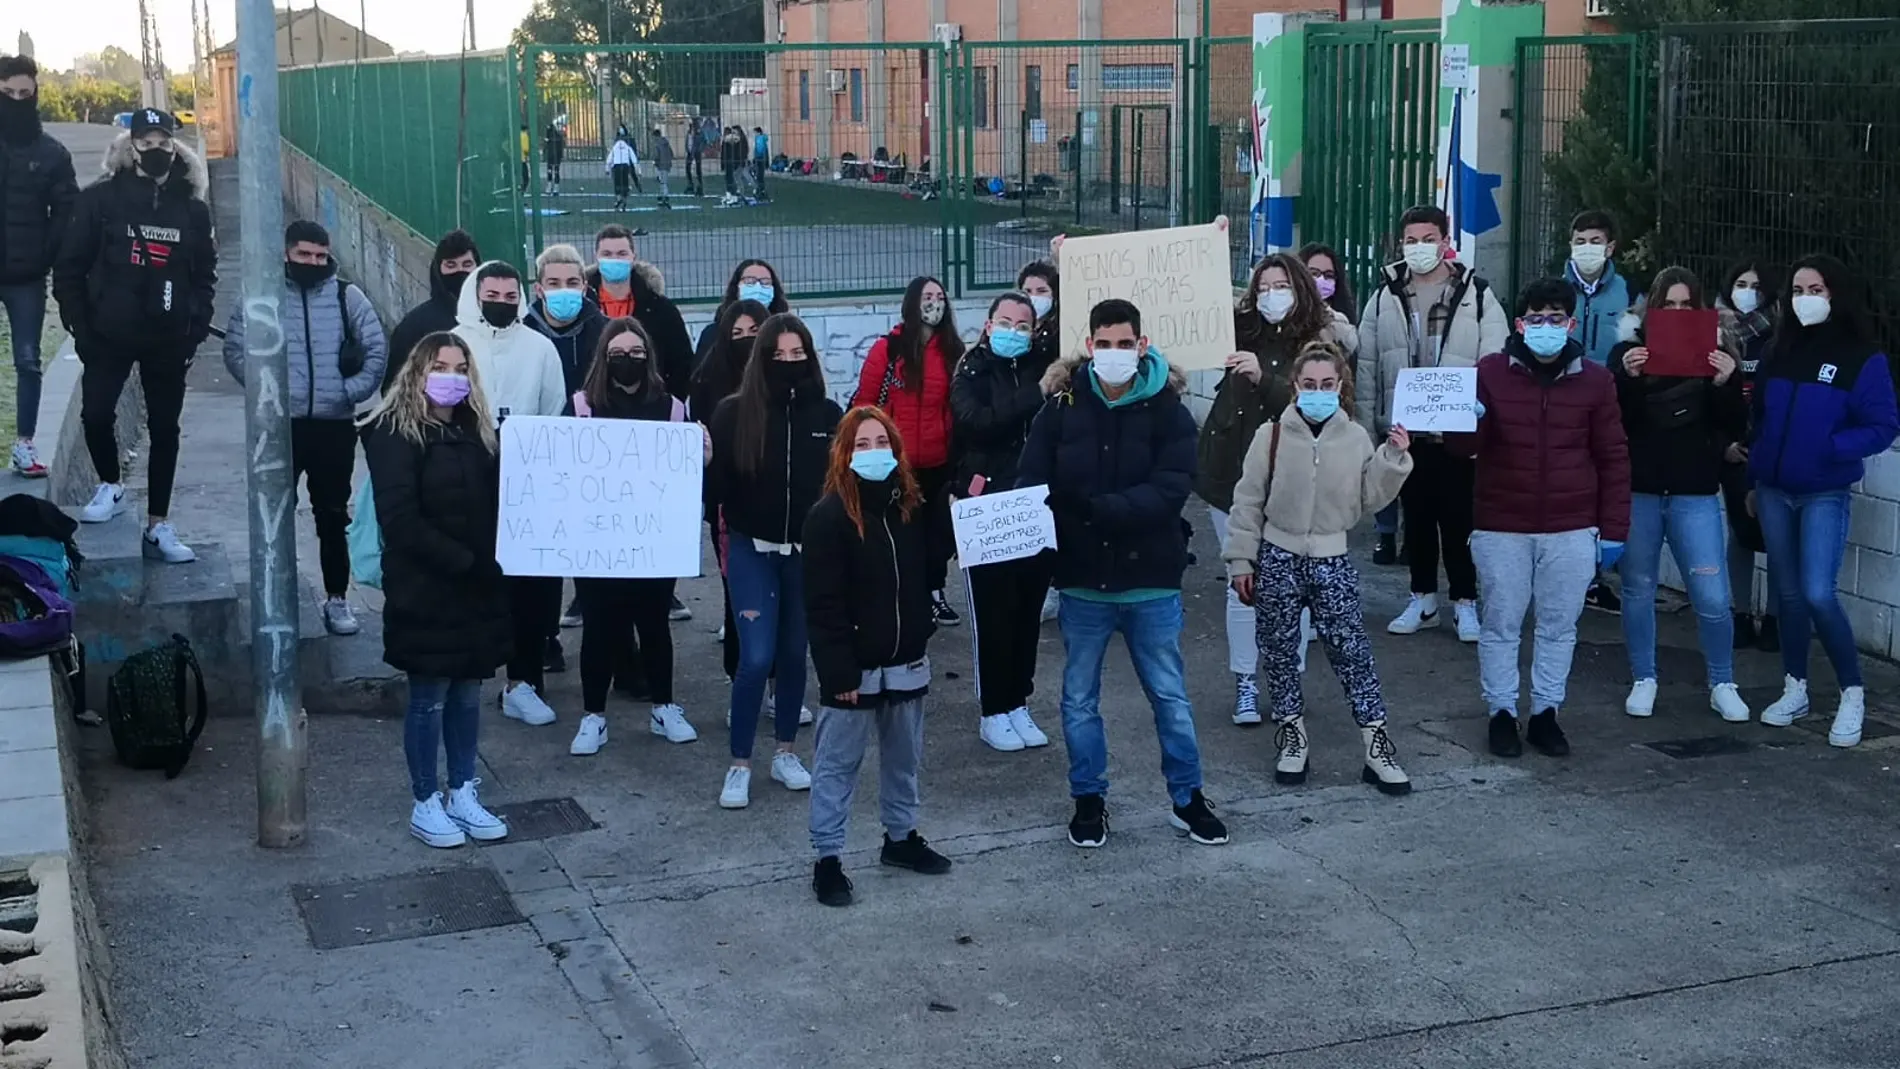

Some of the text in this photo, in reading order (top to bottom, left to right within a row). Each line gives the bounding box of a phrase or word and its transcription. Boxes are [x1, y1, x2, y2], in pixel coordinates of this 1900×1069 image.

[1067, 237, 1214, 282] MENOS INVERTIR
[1130, 274, 1196, 309] ARMAS
[1427, 394, 1444, 403] NO
[514, 425, 699, 476] VAMOS A POR
[505, 473, 536, 506] LA
[580, 475, 634, 503] OLA
[649, 480, 668, 501] Y
[506, 508, 663, 541] VA A SER UN
[974, 508, 1044, 536] SUBIENDO
[531, 546, 656, 571] TSUNAMI
[962, 538, 974, 552] Y
